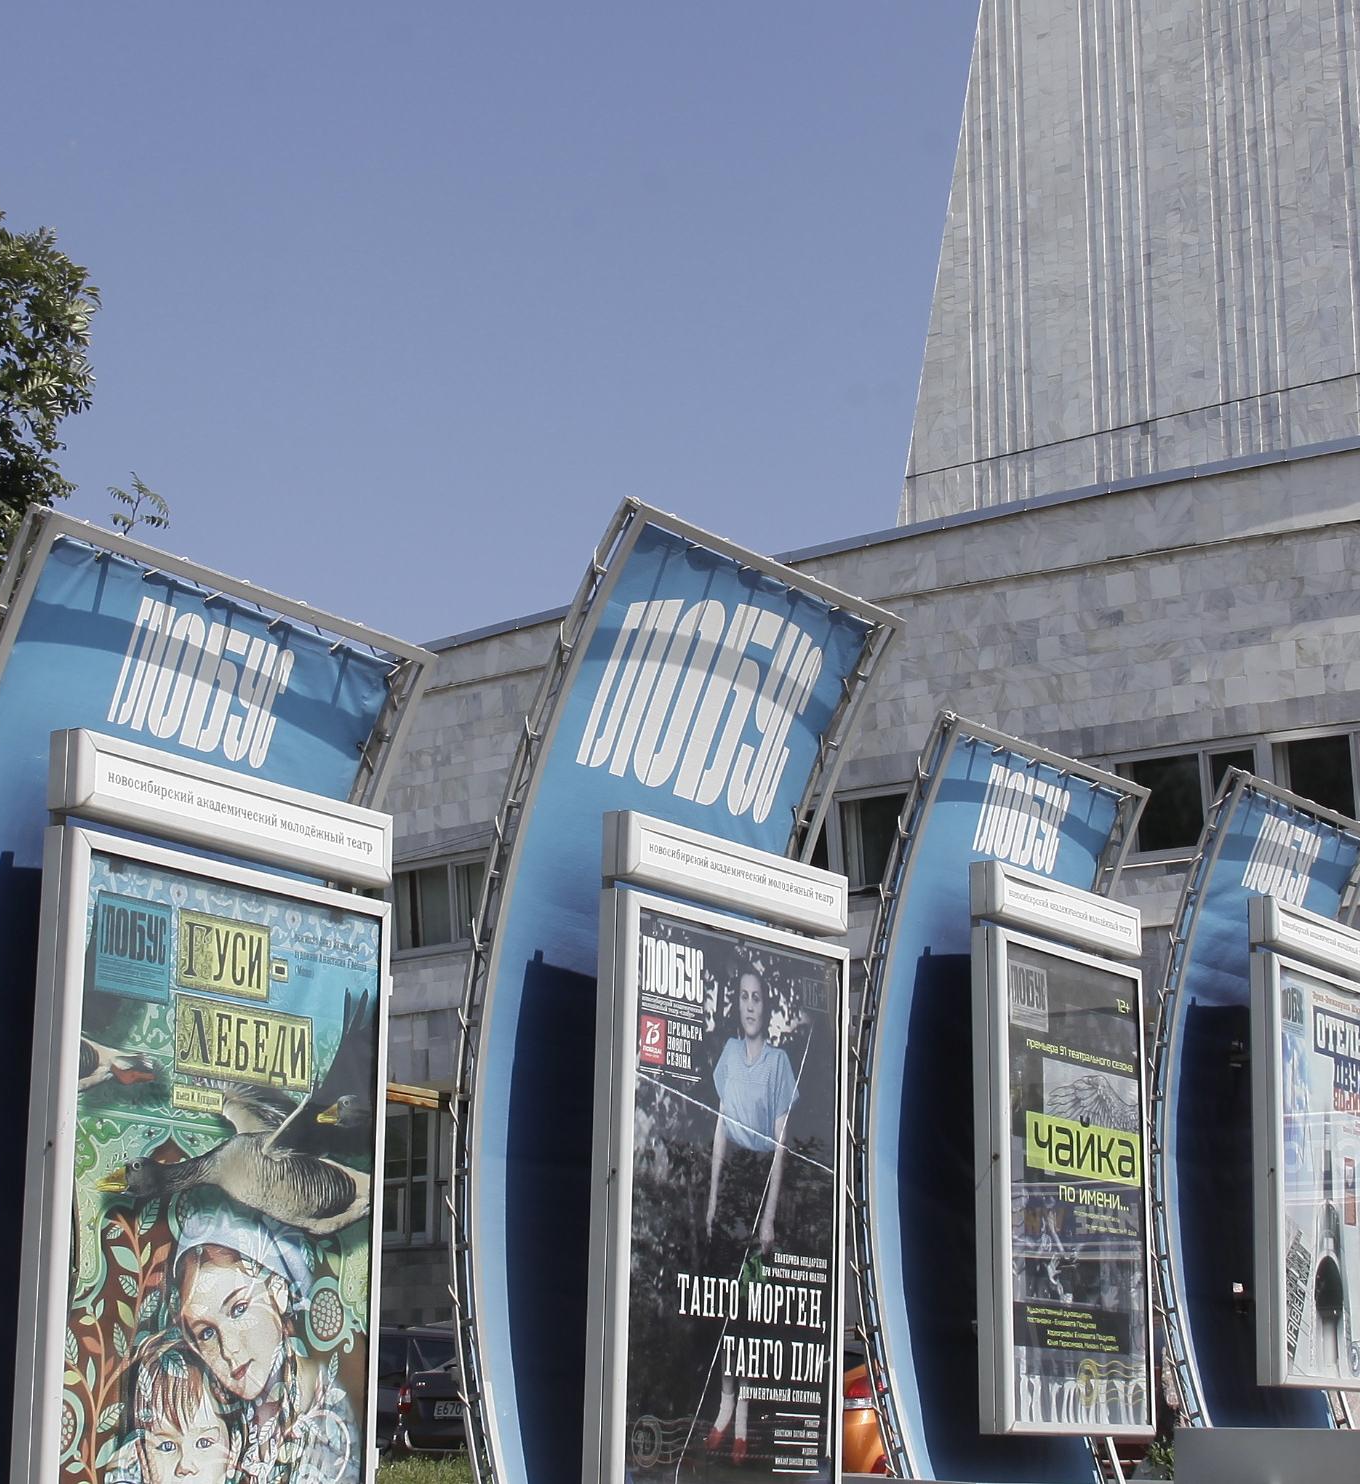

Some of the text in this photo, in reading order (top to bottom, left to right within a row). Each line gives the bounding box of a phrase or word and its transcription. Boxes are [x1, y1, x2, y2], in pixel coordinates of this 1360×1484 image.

[107, 596, 295, 769] ГЛОБУС
[576, 599, 823, 824] ГЛОБУС
[108, 771, 373, 855] новосибирский академический молодёжный театр
[972, 763, 1071, 875] ГЛОБУС
[649, 843, 708, 869] новосибирский
[710, 861, 767, 885] академический
[815, 891, 834, 906] театр
[100, 903, 167, 966] ГЛОБУС
[642, 935, 704, 1003] ГЛОБУС
[667, 1020, 703, 1042] ПРЕМЬЕРА
[1116, 998, 1131, 1014] 12+
[666, 1051, 691, 1070] СЕЗОНА
[667, 1035, 691, 1054] НОВОГО
[1026, 1038, 1058, 1054] премьера
[1068, 1047, 1111, 1067] театрального
[1112, 1060, 1133, 1073] сезона
[677, 1273, 826, 1333] ТАНГО МОРГЕН,
[723, 1335, 825, 1383] ТАНГО ПЛИ
[436, 1402, 464, 1416] Е670
[738, 1386, 791, 1402] ДОКУМЕНТАЛЬНЫЙ
